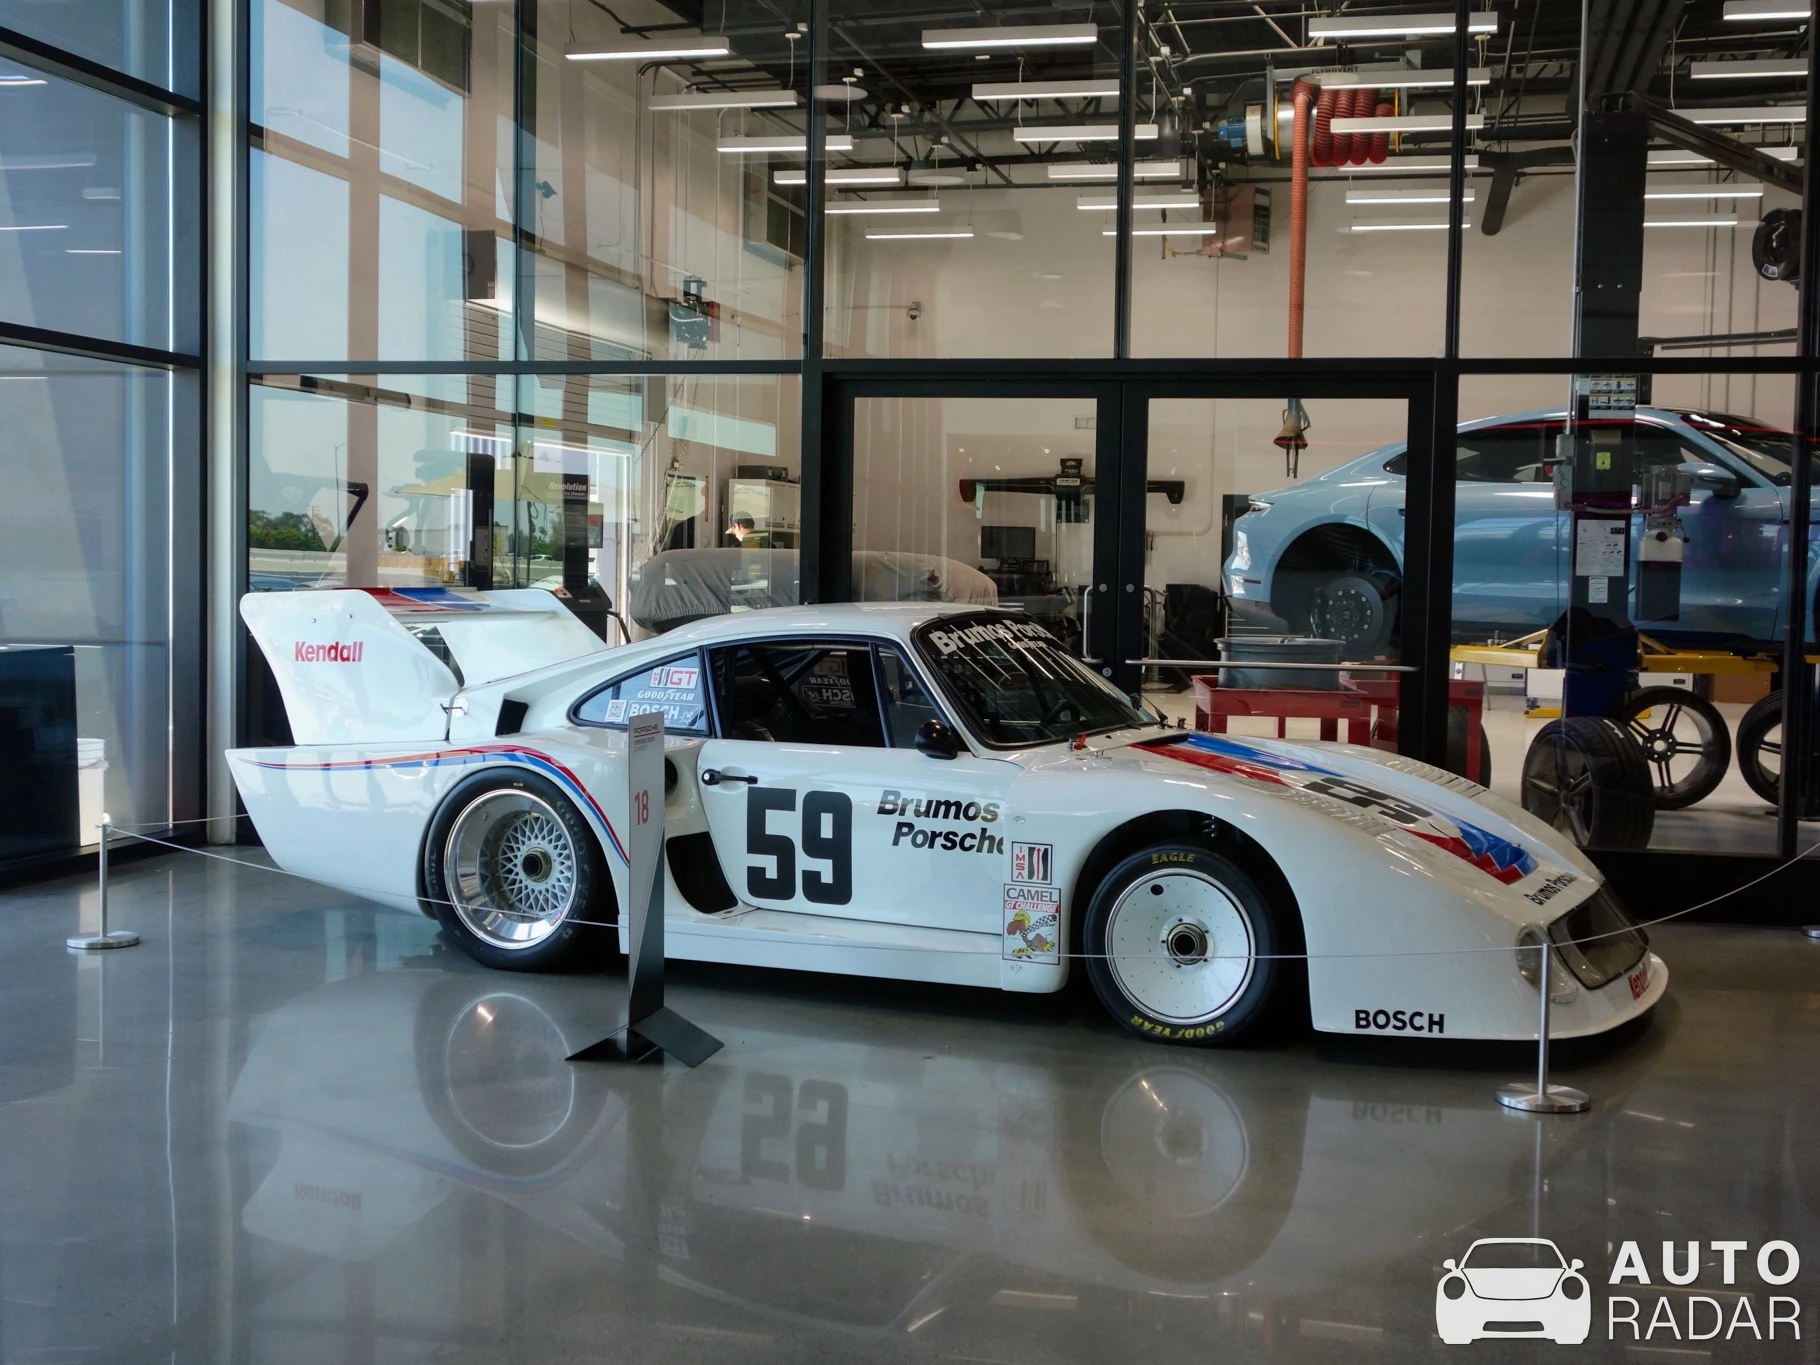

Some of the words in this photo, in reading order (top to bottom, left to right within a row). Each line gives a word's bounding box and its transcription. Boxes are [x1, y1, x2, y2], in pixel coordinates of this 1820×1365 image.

[549, 482, 587, 491] Revolution
[294, 641, 364, 662] Kendall
[669, 670, 698, 686] GT
[634, 789, 650, 825] 18
[876, 789, 1000, 823] Brumos
[746, 786, 853, 906] 59
[1015, 845, 1026, 880] IMSA
[1151, 852, 1196, 865] EAGLE
[1006, 887, 1058, 903] CAMEL
[1005, 900, 1016, 910] GT
[1016, 901, 1058, 913] CHALLENGE
[1354, 1009, 1445, 1034] BOSCH
